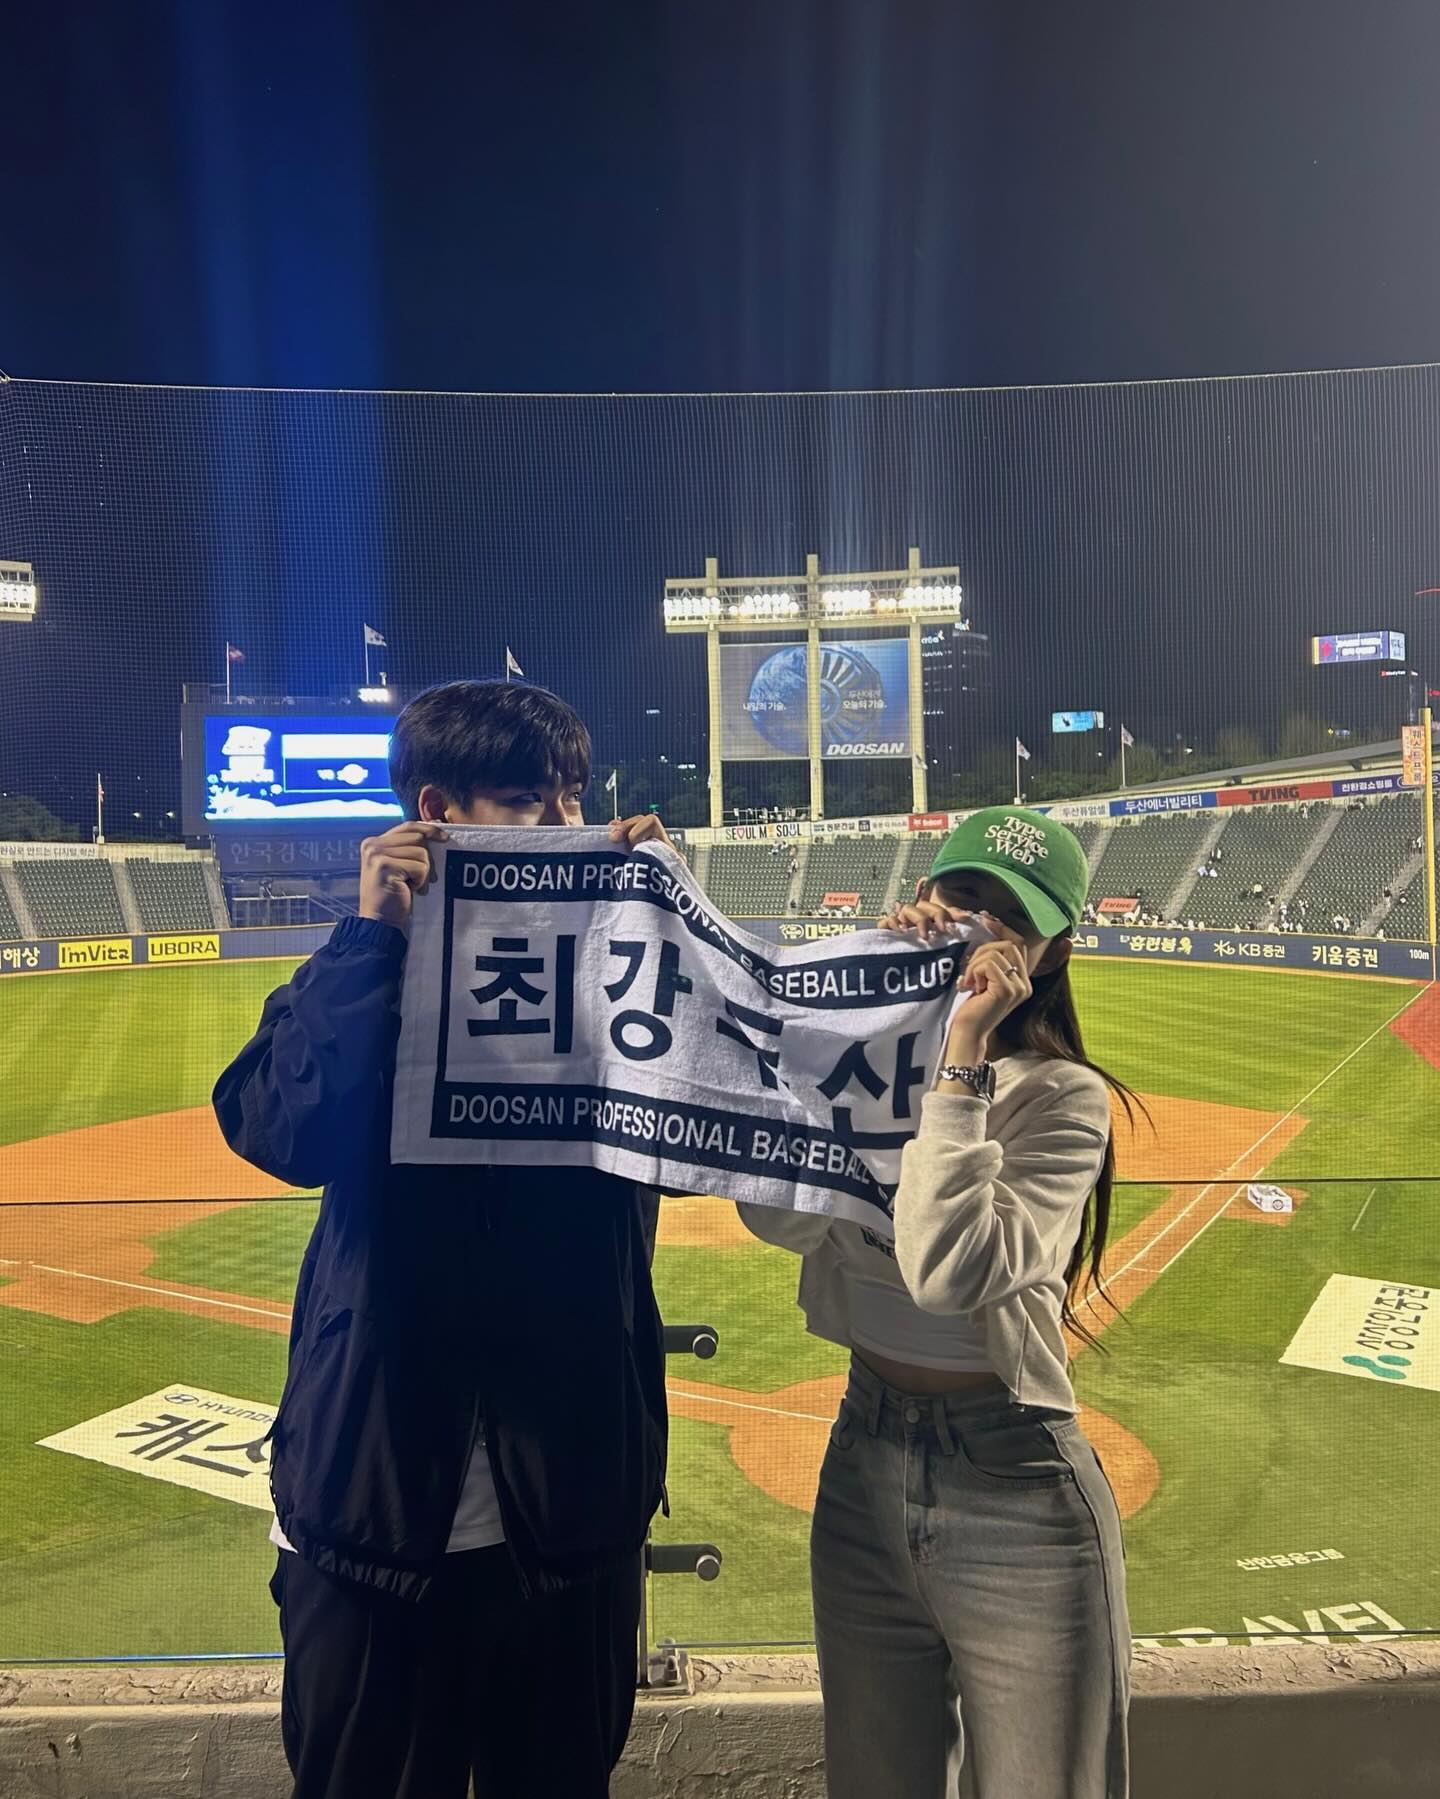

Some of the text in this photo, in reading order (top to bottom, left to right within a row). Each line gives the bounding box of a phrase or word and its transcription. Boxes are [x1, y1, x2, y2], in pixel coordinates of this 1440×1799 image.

[826, 742, 905, 756] DOOSAN
[1125, 794, 1202, 813] 두산에너빌리티
[1248, 787, 1300, 801] TVING
[1062, 804, 1106, 818] 두산퓨얼셀
[1003, 816, 1046, 841] Type
[984, 824, 1049, 859] Service
[462, 863, 575, 891] DOOSAN
[741, 959, 875, 999] BASEBALL
[883, 956, 955, 996] CLUB
[0, 946, 41, 969] 해상
[150, 940, 218, 957] UBORA
[1312, 945, 1379, 968] 키움증권
[1409, 949, 1430, 960] 100m
[449, 1094, 871, 1185] DOOSAN PROFESSIONAL BASEBALL
[1355, 1284, 1431, 1351] 상상인증권
[197, 1401, 277, 1423] HYUNDA
[115, 1413, 274, 1478] 캐스
